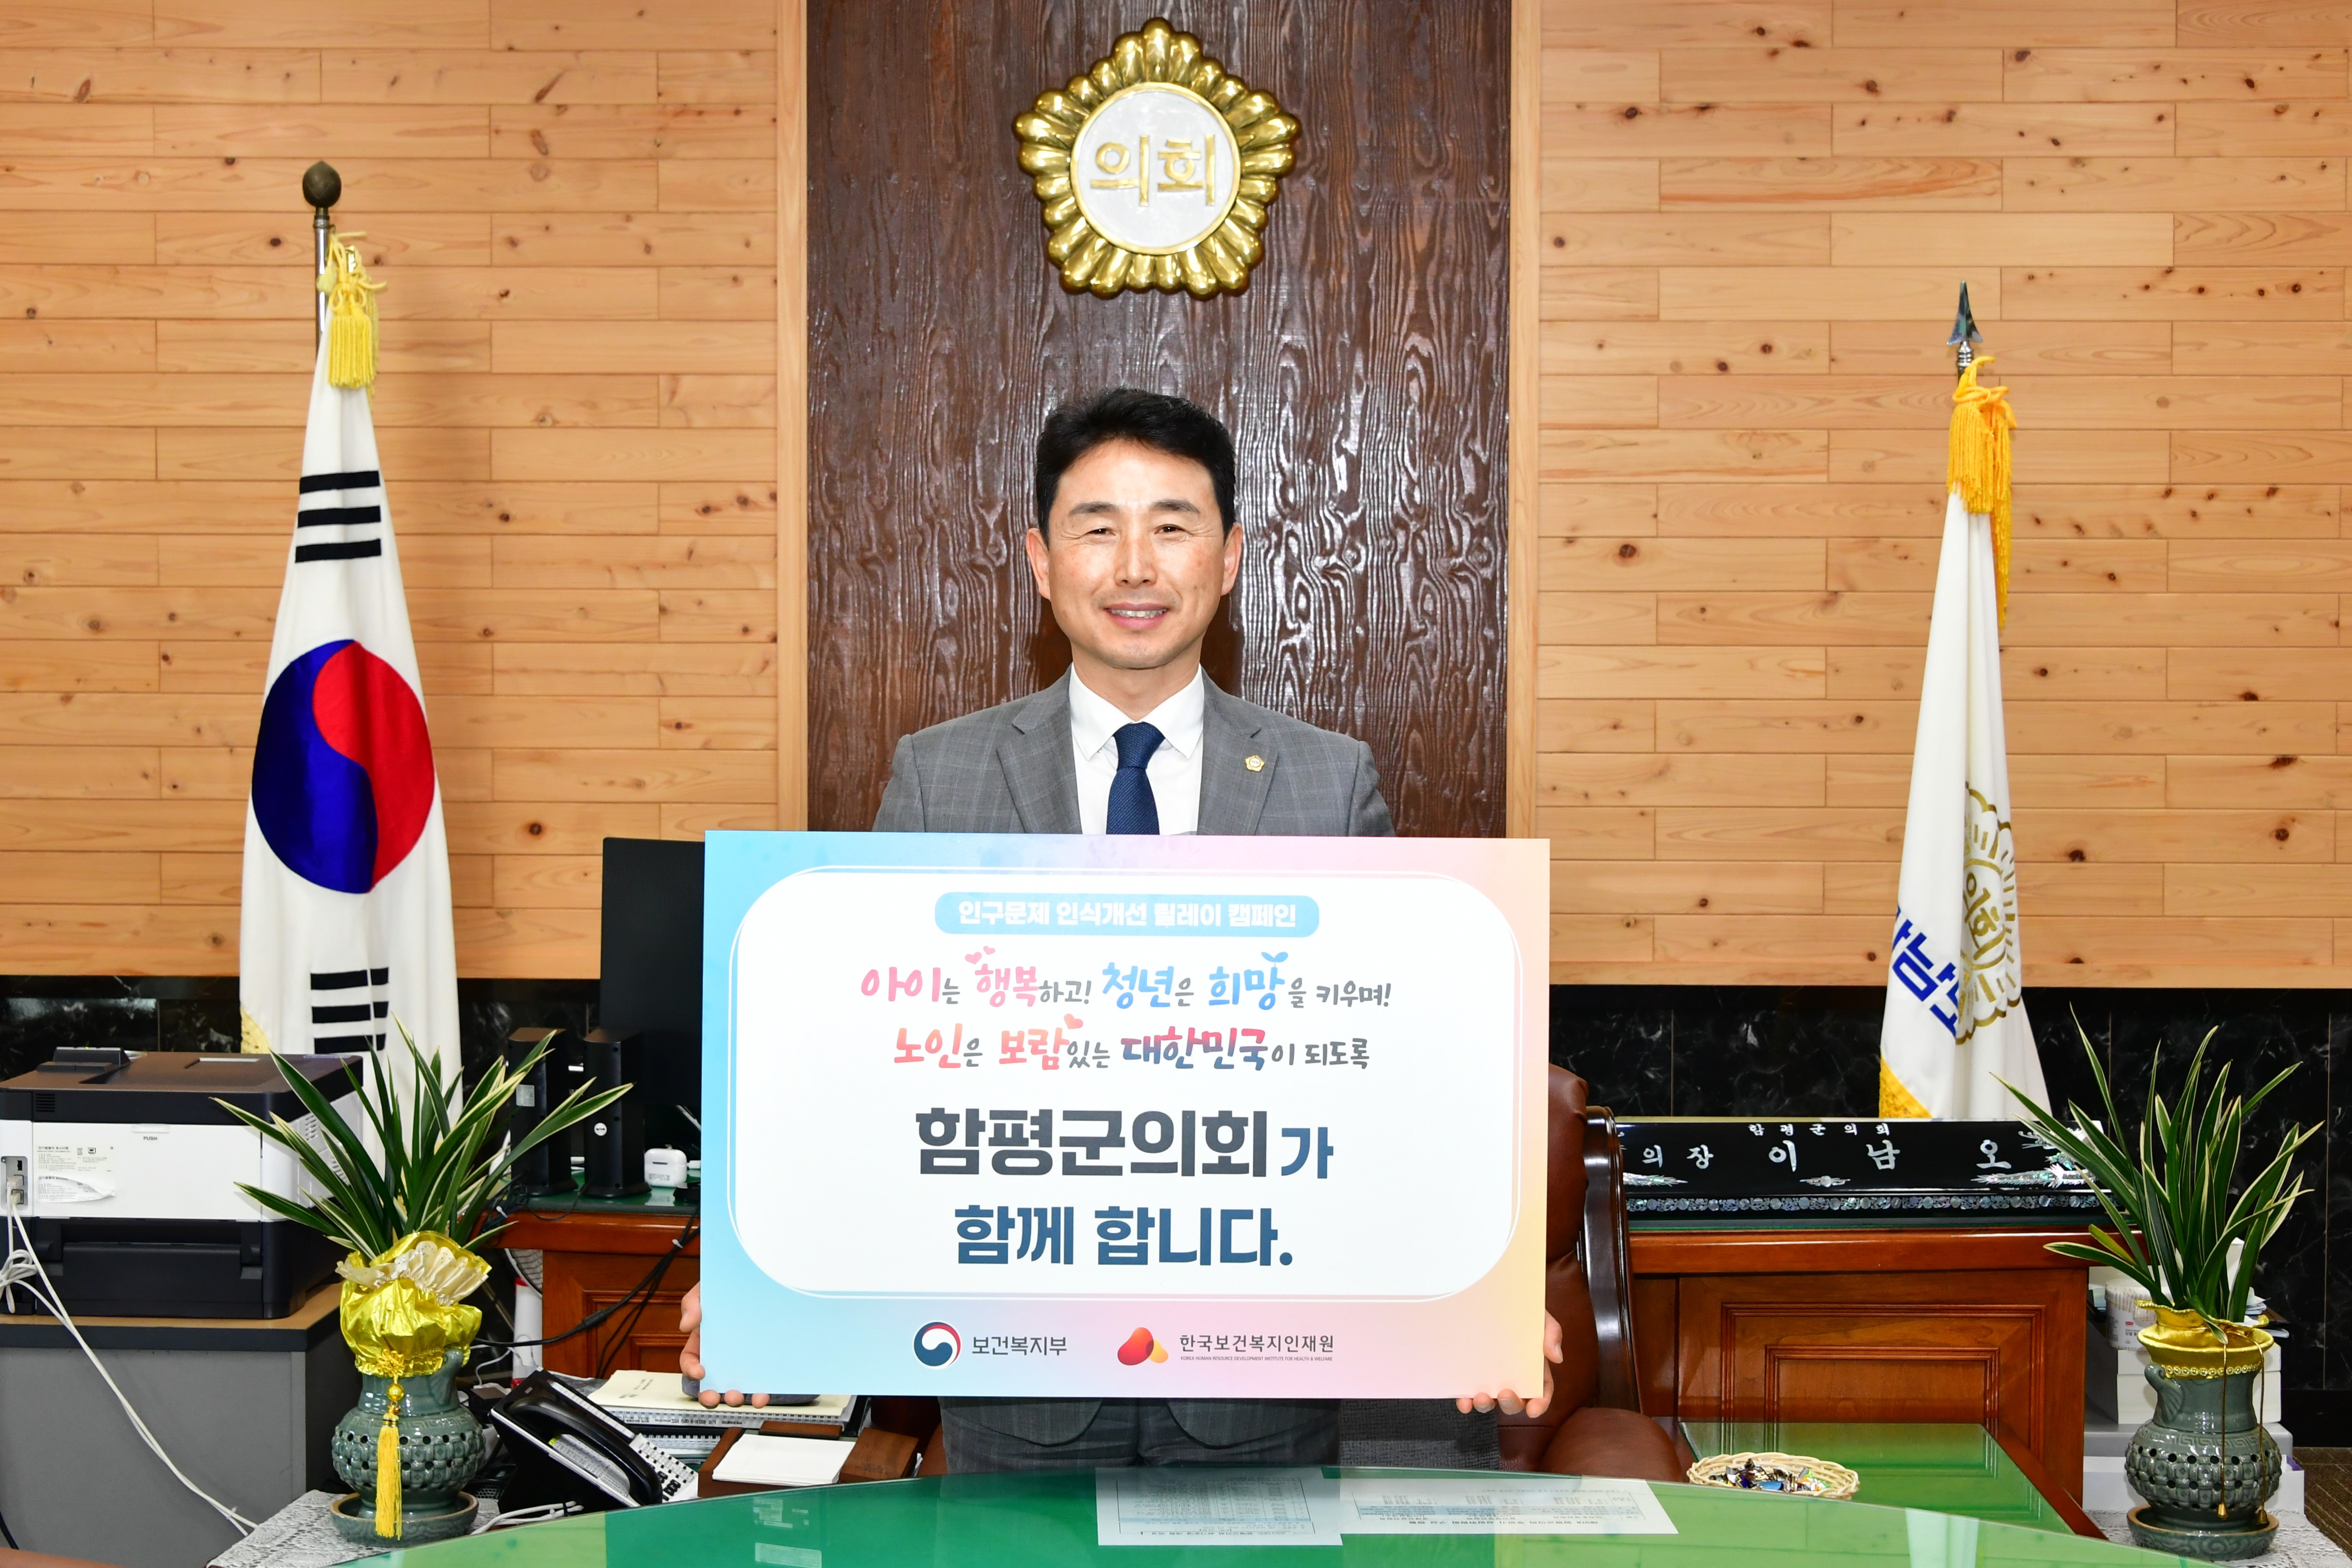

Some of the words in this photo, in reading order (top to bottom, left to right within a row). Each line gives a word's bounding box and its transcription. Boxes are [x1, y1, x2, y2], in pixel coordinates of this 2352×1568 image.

[1090, 134, 1215, 206] 의회
[959, 901, 1050, 925] 인구문제
[1056, 902, 1147, 926] 인식개선
[1154, 903, 1221, 926] 릴레이
[1228, 903, 1296, 927] 캠페인
[861, 966, 960, 1005] 아이는
[975, 963, 1092, 1007] 행복하고!
[1102, 962, 1195, 1009] 청년은
[1208, 965, 1307, 1011] 희망을
[1316, 980, 1392, 1008] 키우며!
[894, 1023, 983, 1068] 노인은
[999, 1027, 1111, 1071] 보람있는
[1120, 1025, 1295, 1071] 대한민국이
[1305, 1037, 1370, 1070] 되도록
[954, 1204, 1074, 1265] 함께
[1094, 1205, 1293, 1267] 합니다.
[971, 1336, 1067, 1356] 보건복지부
[1179, 1334, 1333, 1352] 한국보건복지인재원
